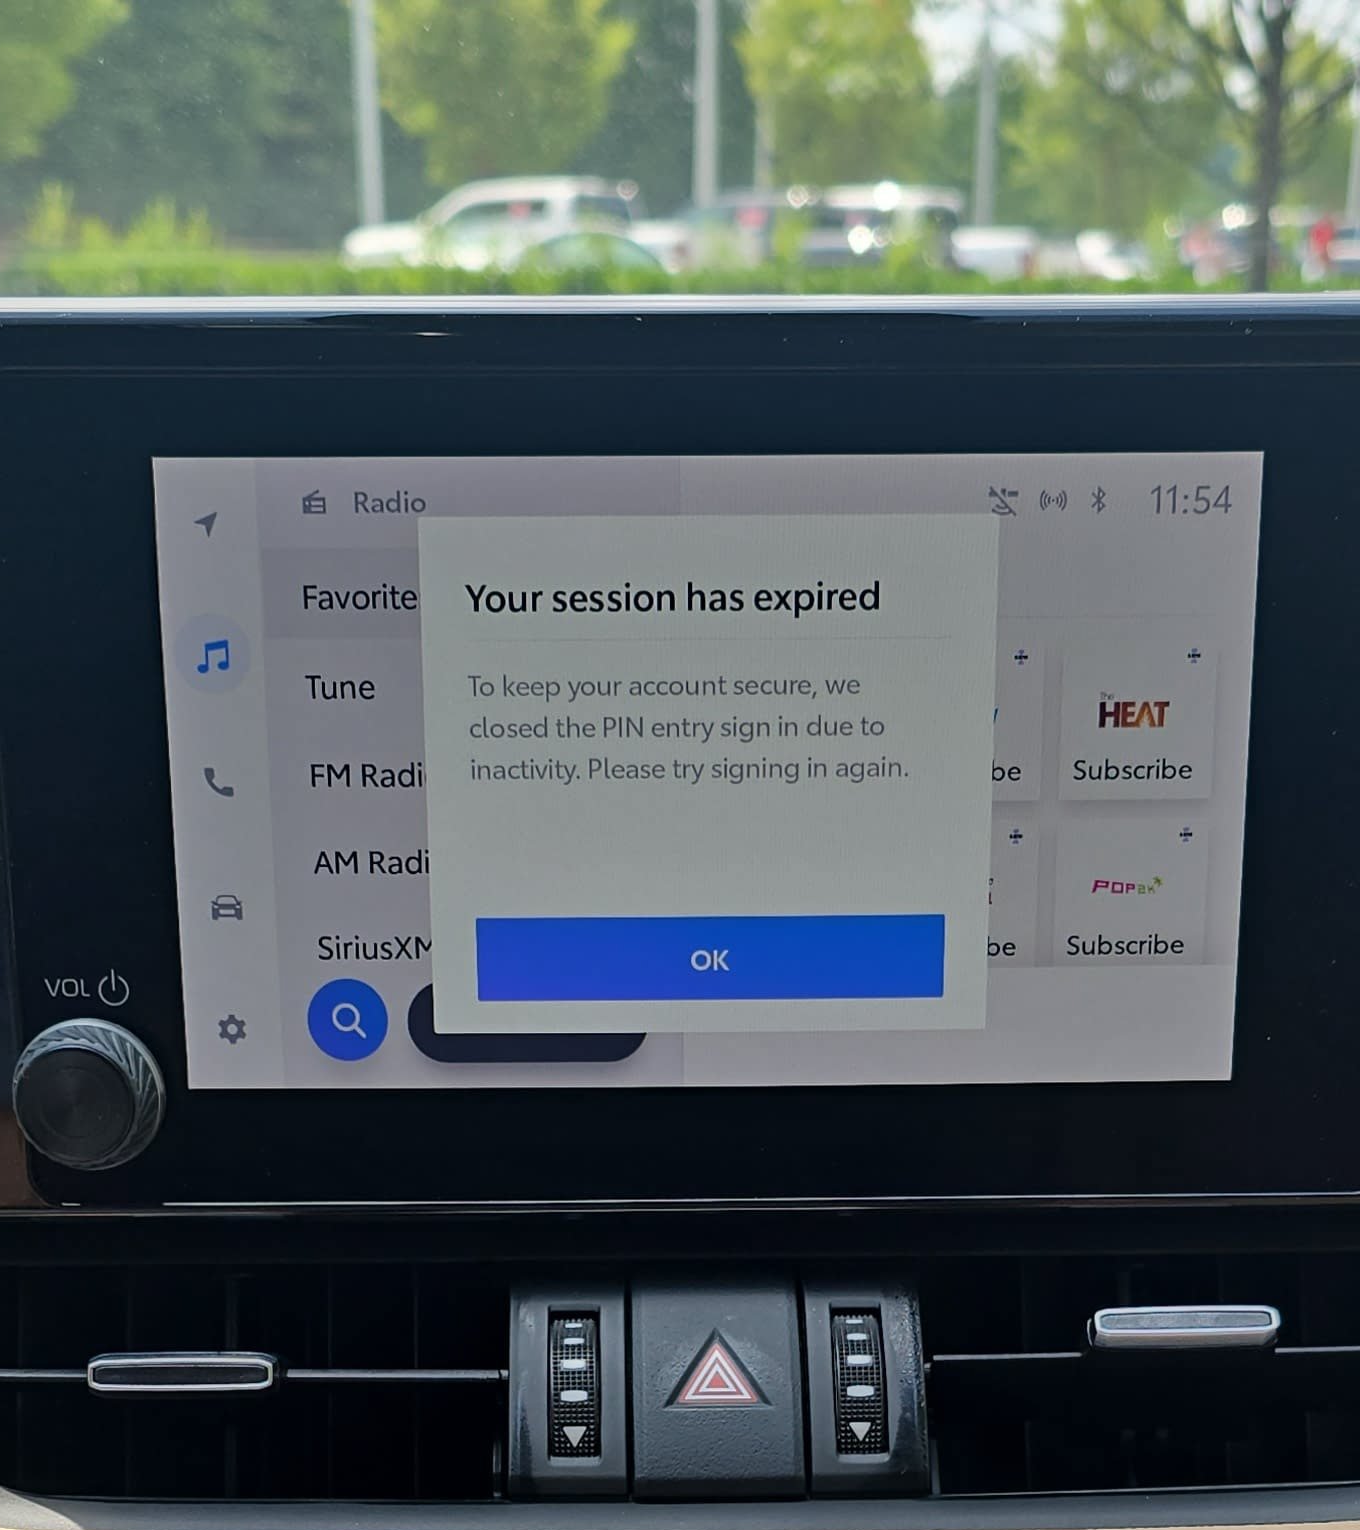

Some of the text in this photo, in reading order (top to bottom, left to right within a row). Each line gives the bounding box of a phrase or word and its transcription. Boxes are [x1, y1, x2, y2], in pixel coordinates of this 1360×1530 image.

[353, 489, 426, 515] Radio
[1150, 484, 1233, 515] 11:54
[301, 584, 418, 612] Favorite
[465, 580, 881, 618] Your session has expired
[305, 674, 376, 702] Tune
[467, 674, 861, 703] To keep your account secure, we
[1098, 701, 1170, 729] HEAT
[469, 714, 886, 744] closed the PIN entry sign in due to
[310, 761, 427, 788] FM Radi
[471, 755, 909, 785] inactivity. Please try signing in again.
[1072, 758, 1193, 781] Subscribe
[314, 850, 359, 875] AM
[318, 934, 433, 961] SiriusXM
[1066, 934, 1185, 957] Subscribe
[690, 949, 730, 973] OK
[43, 978, 91, 997] VOL
